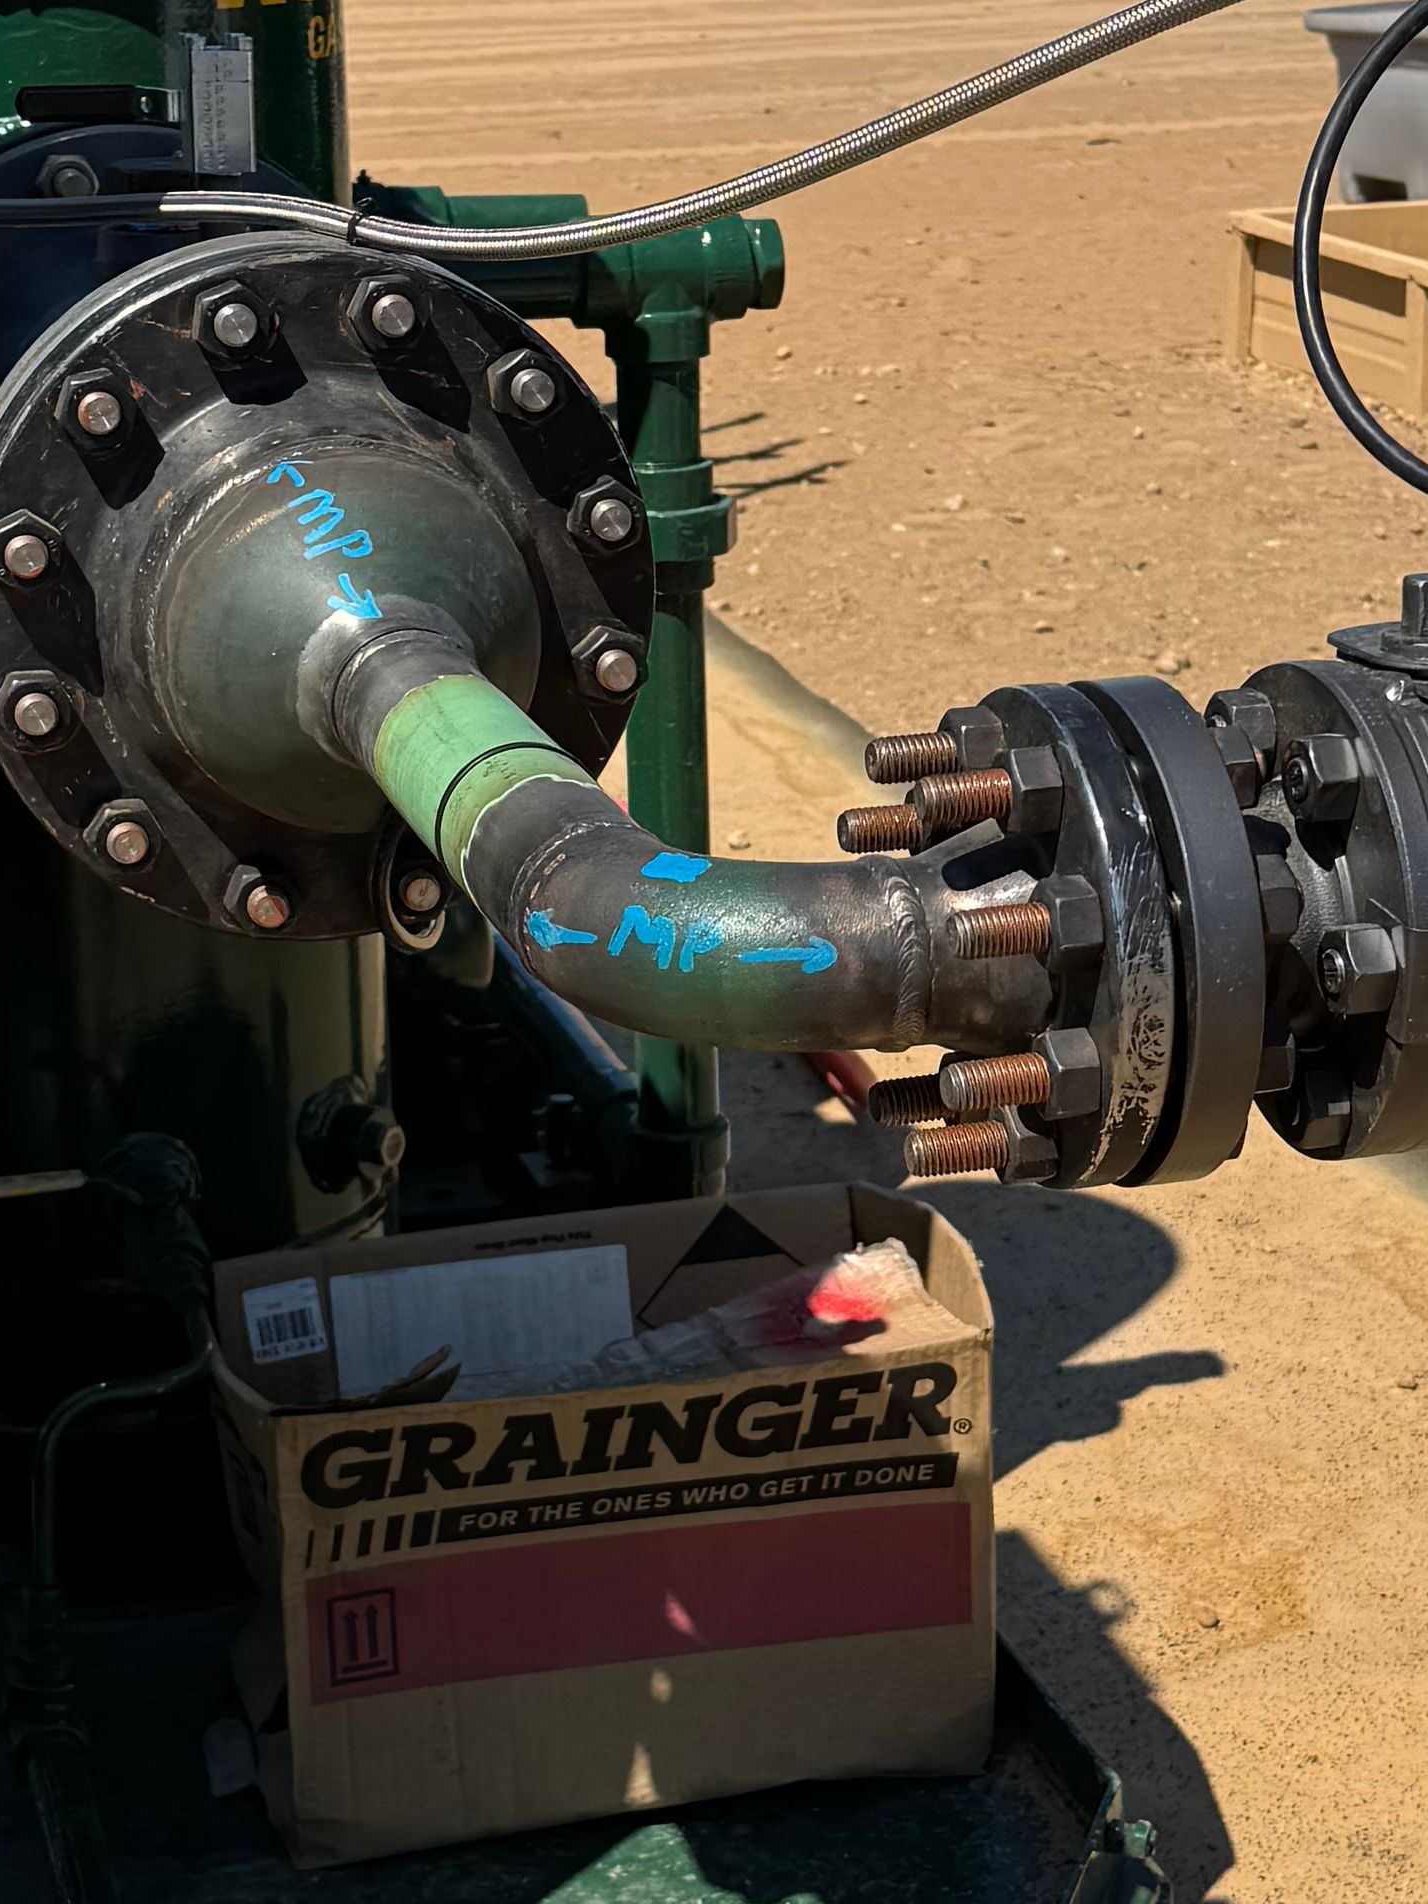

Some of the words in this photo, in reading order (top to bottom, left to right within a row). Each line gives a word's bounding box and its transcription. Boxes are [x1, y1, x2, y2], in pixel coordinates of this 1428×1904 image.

[608, 905, 725, 972] MP
[300, 1361, 958, 1509] GRAINGER
[459, 1510, 518, 1534] FOR
[528, 1501, 582, 1526] THE
[592, 1491, 673, 1519] ONES
[681, 1481, 750, 1508] WHO
[759, 1474, 814, 1499] GET
[820, 1469, 844, 1491] IT
[855, 1463, 935, 1487] DONE
